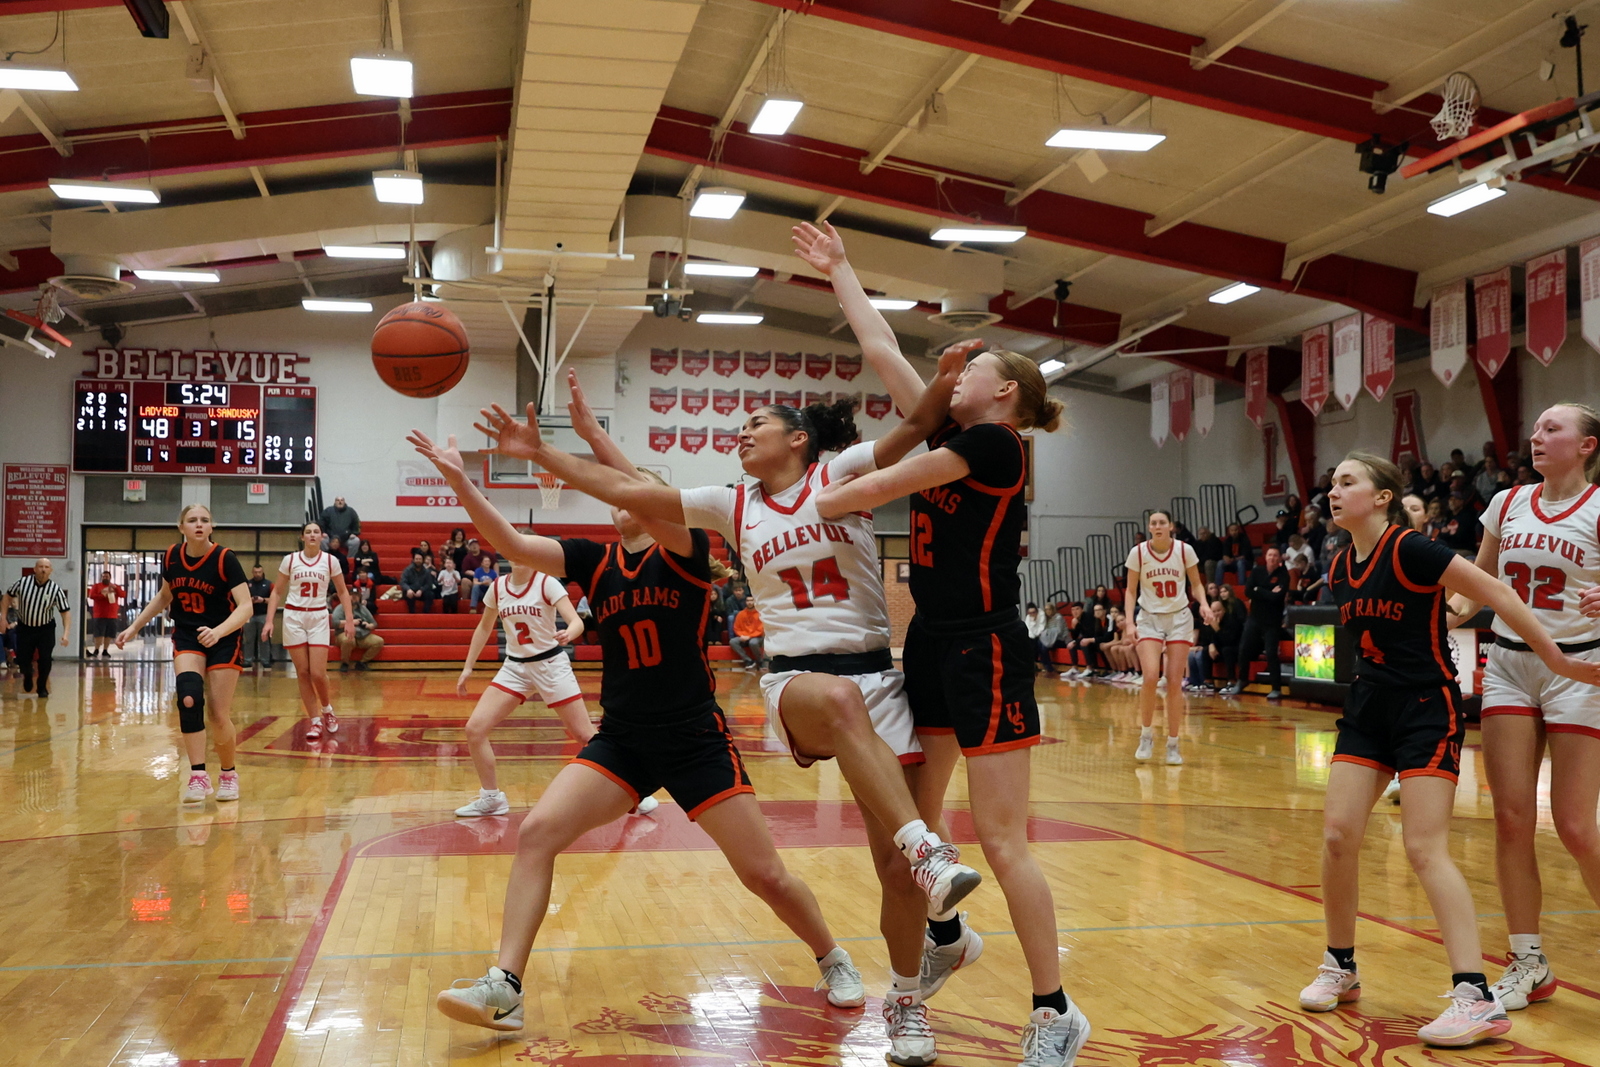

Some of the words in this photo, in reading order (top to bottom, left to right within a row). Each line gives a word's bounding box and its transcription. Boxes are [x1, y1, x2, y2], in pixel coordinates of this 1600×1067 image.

[97, 349, 297, 384] BELLEVUE
[120, 392, 127, 404] 7
[182, 384, 227, 405] 5:24
[81, 406, 94, 416] 14
[98, 406, 106, 418] 2
[119, 407, 127, 417] 4
[140, 406, 162, 416] LADY
[162, 406, 179, 416] RED
[185, 412, 208, 420] PERIOD
[114, 420, 127, 431] 15
[142, 418, 169, 438] 48
[192, 421, 202, 437] 3
[237, 420, 255, 440] 15
[265, 435, 281, 447] 20
[304, 436, 313, 448] 0
[160, 451, 169, 461] 4
[223, 451, 231, 463] 2
[244, 449, 254, 464] 2
[265, 449, 280, 460] 25
[285, 449, 293, 460] 0
[304, 449, 313, 461] 0
[284, 462, 293, 473] 2
[8, 472, 51, 483] BELLEVUE
[54, 473, 65, 484] HS
[752, 522, 854, 574] BELLEVUE
[293, 571, 325, 582] BELLEVUE
[1146, 568, 1180, 579] BELLEVUE
[188, 577, 215, 595] RAMS
[777, 555, 850, 612] 14
[1152, 580, 1177, 598] 30
[1504, 560, 1567, 611] 32
[300, 582, 319, 598] 21
[178, 592, 205, 614] 20
[596, 591, 626, 624] LADY
[632, 586, 680, 609] RAMS
[1355, 598, 1405, 621] RAMS
[515, 622, 534, 646] 2
[618, 619, 662, 670] 10
